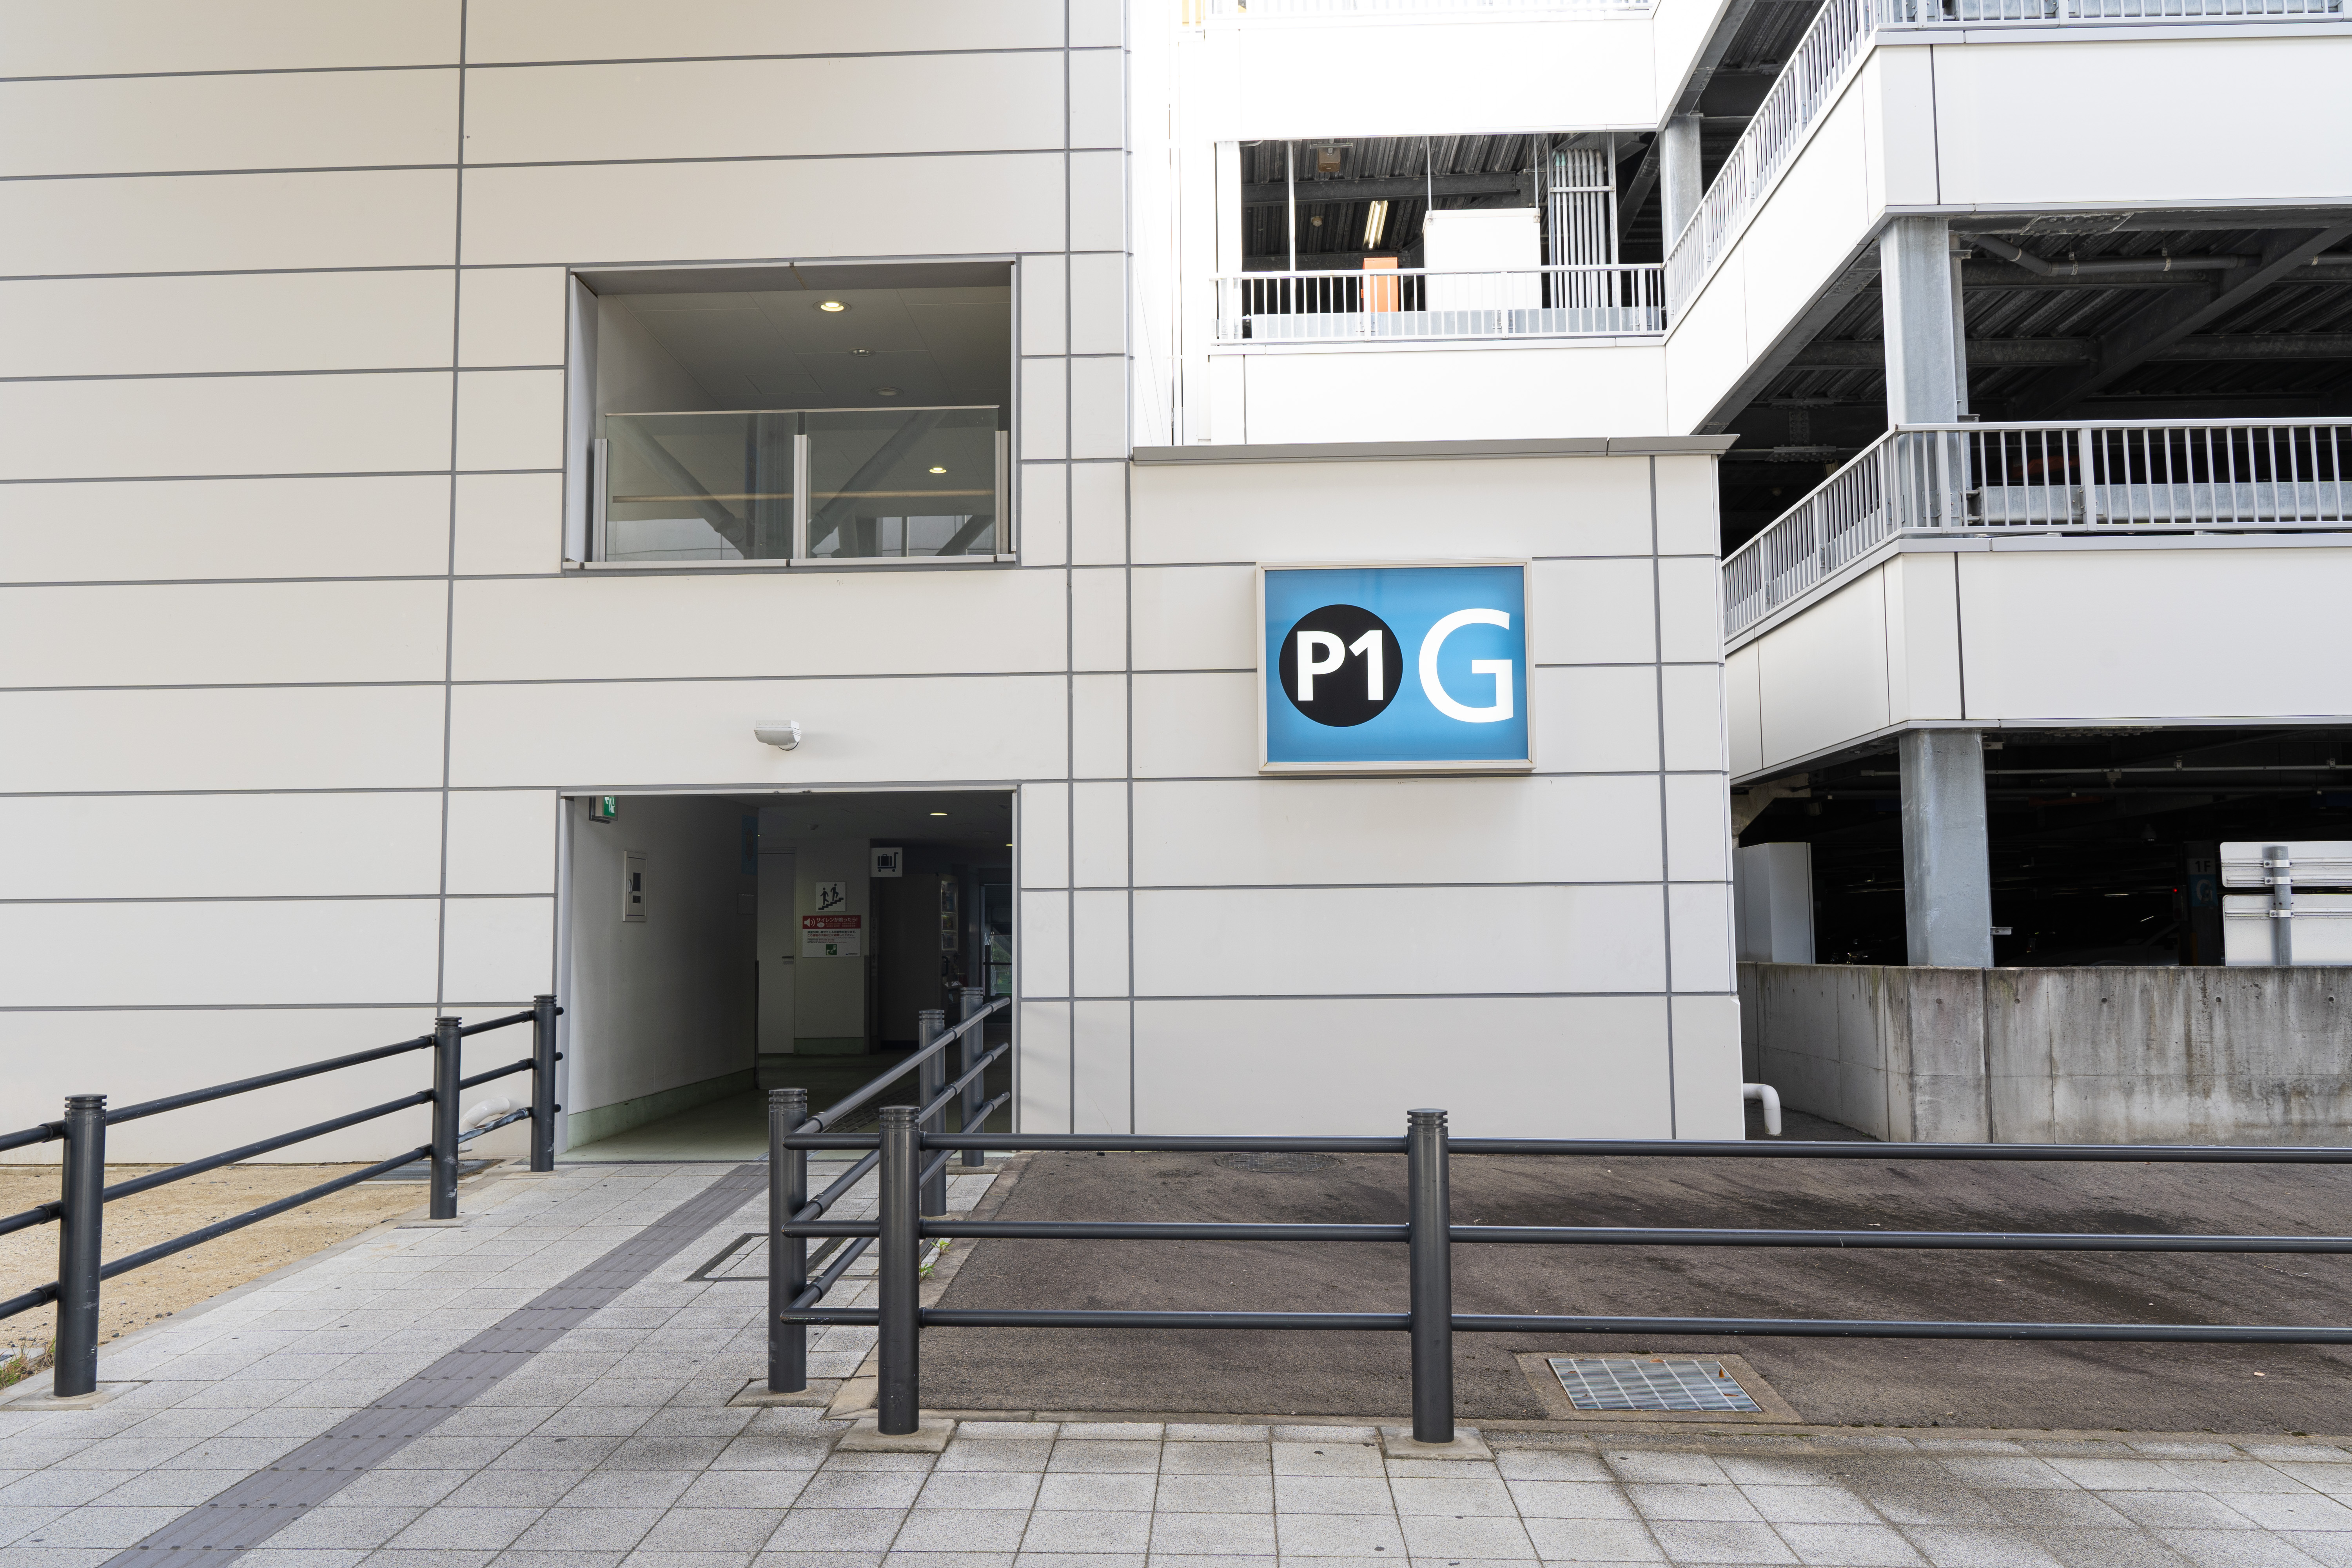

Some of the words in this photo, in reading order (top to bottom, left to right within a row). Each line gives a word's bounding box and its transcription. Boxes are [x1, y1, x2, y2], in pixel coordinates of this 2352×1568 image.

[1297, 630, 1384, 701] P1
[1418, 608, 1514, 723] G
[2195, 860, 2210, 872] 1F
